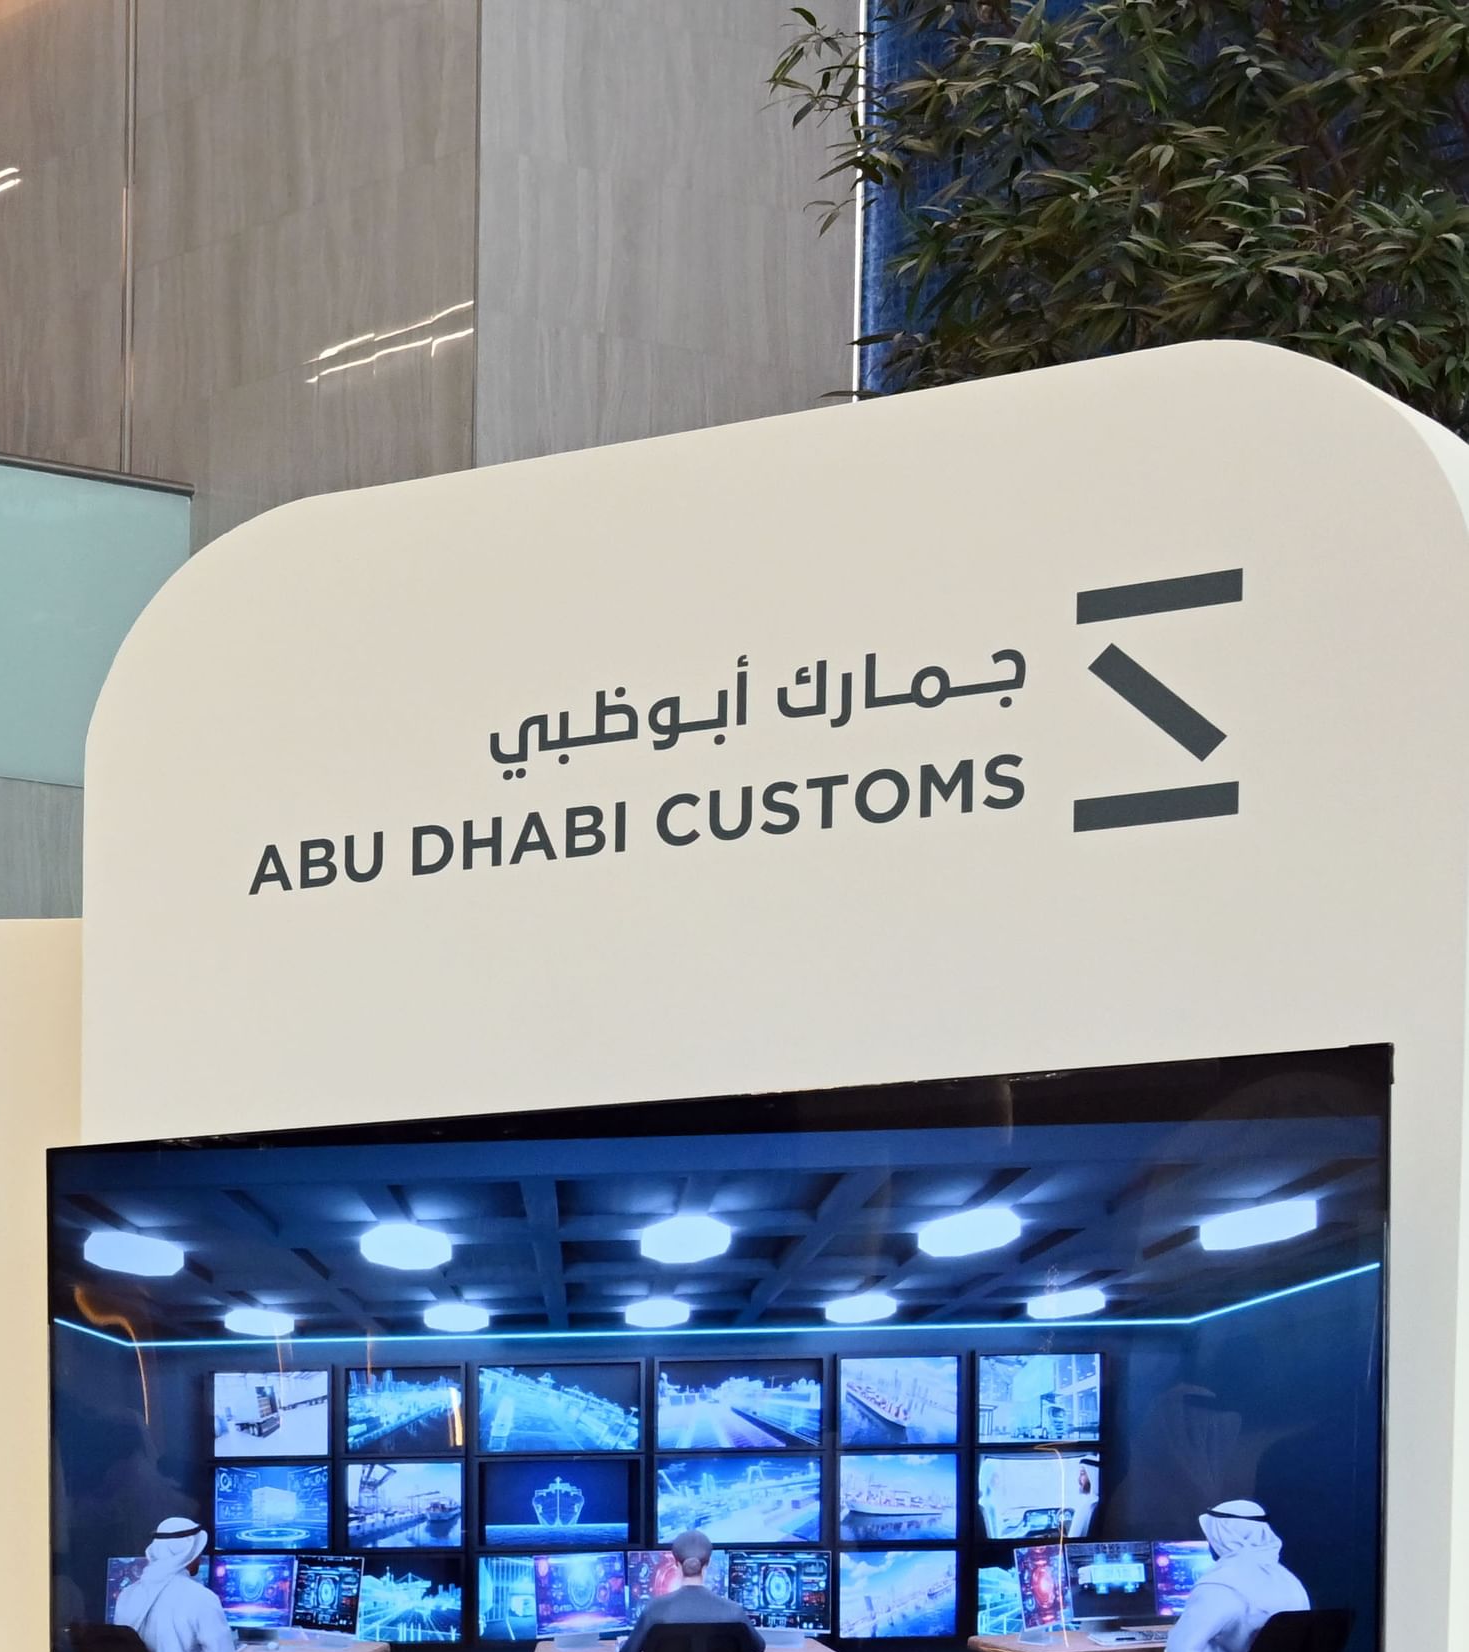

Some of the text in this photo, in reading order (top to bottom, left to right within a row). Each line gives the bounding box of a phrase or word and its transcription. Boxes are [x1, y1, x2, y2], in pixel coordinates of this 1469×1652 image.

[777, 648, 1026, 735] جمارك
[248, 753, 1025, 896] ABU DHABI CUSTOMS
